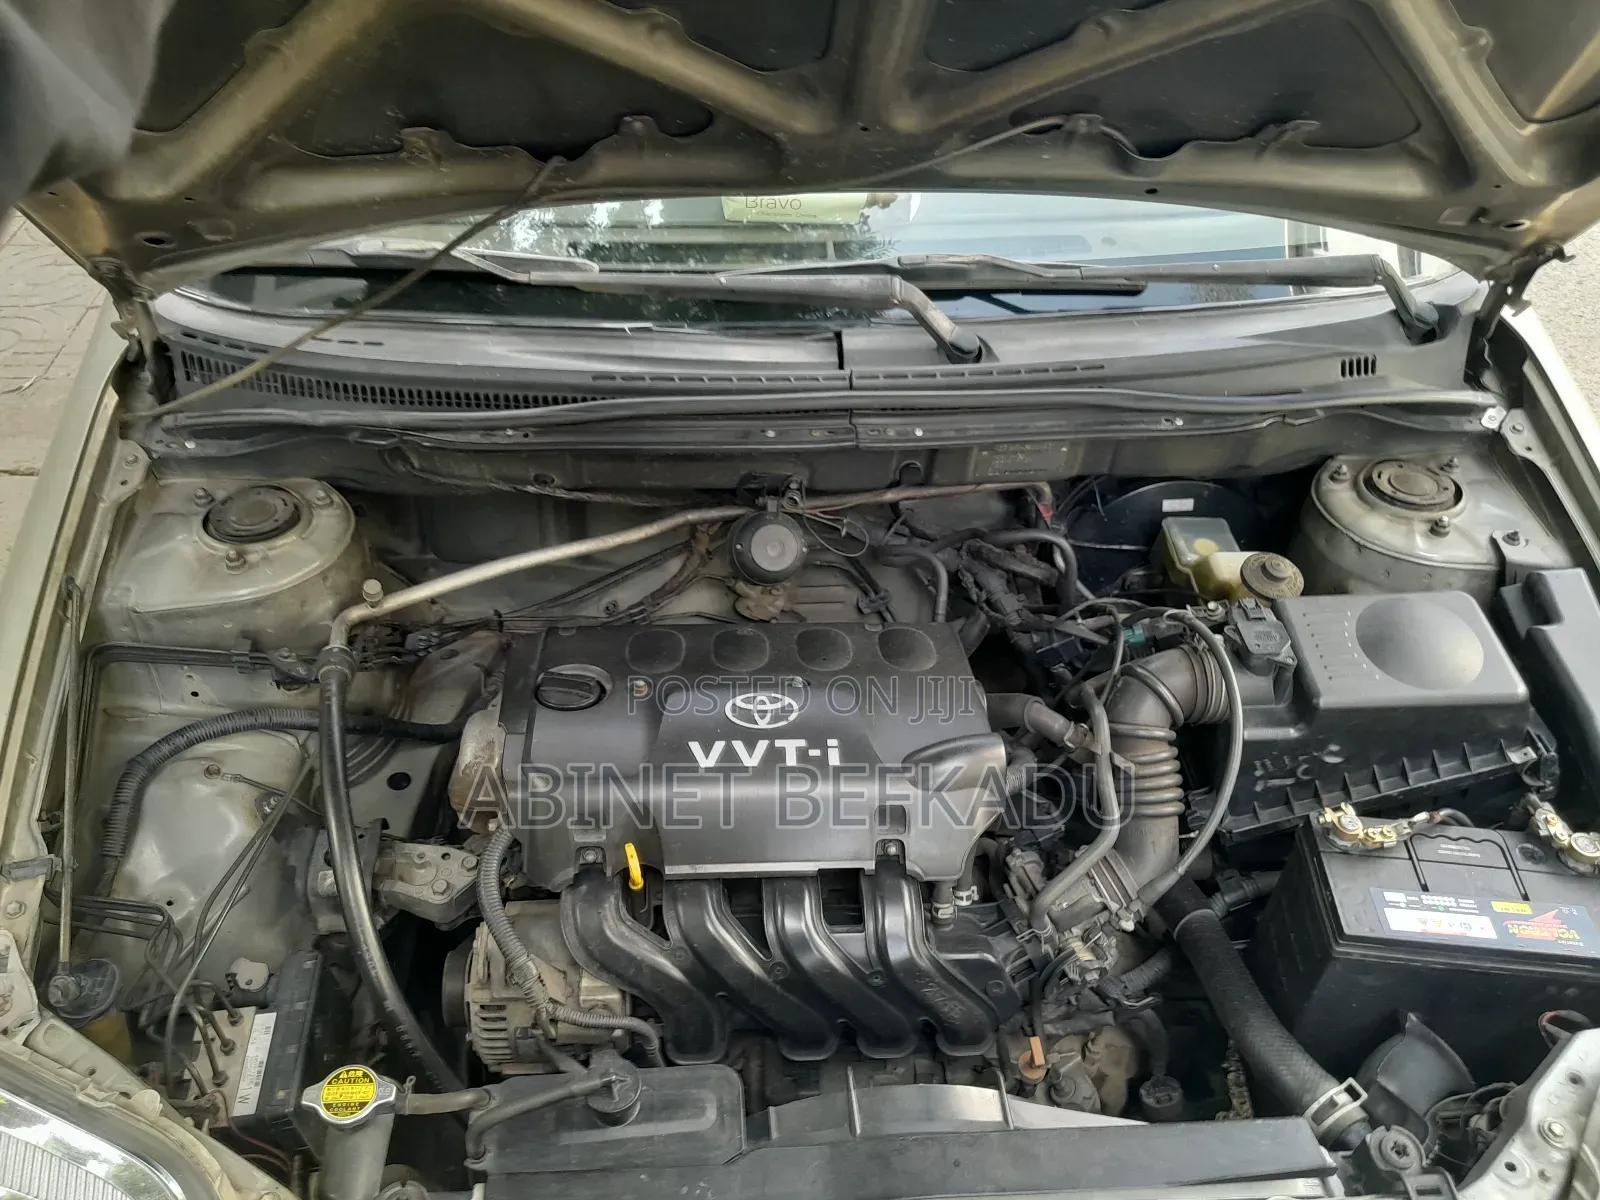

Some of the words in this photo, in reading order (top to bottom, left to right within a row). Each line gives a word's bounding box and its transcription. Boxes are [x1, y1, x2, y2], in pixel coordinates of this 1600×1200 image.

[745, 195, 802, 210] Bravo
[687, 739, 840, 768] VVT-i
[1507, 924, 1580, 940] VOLTRON
